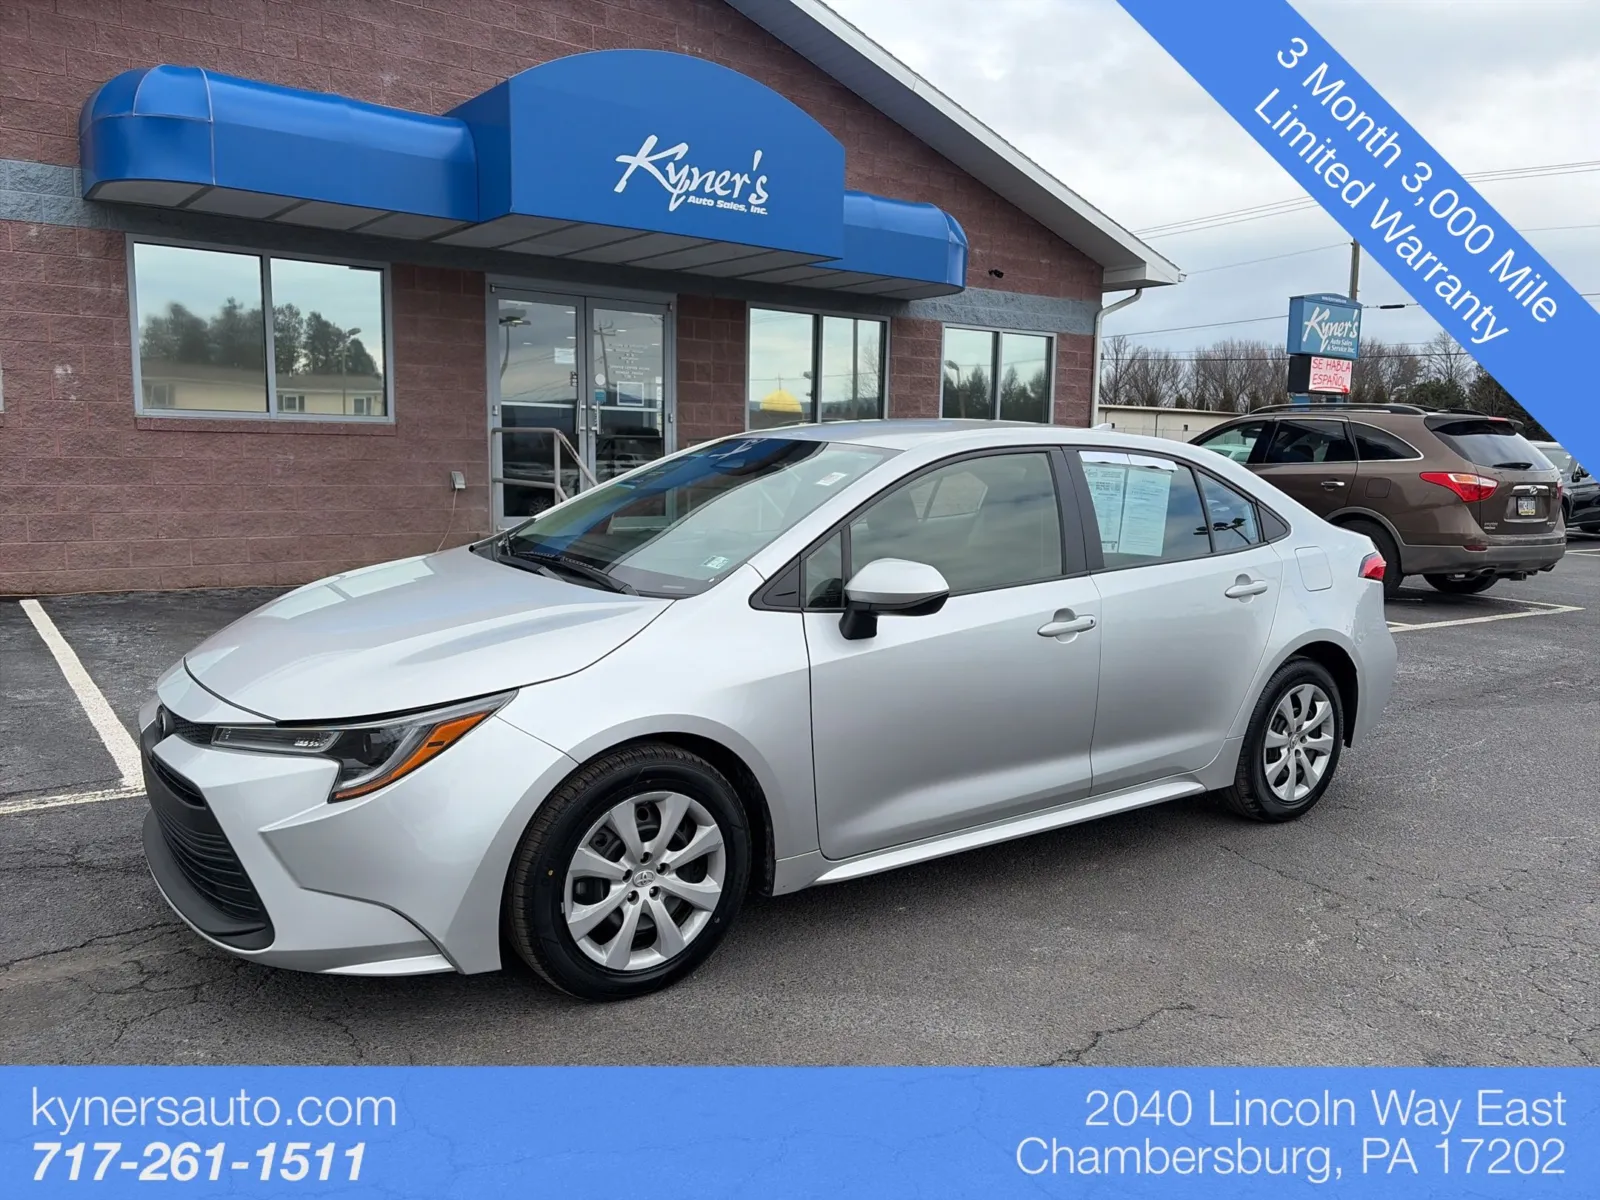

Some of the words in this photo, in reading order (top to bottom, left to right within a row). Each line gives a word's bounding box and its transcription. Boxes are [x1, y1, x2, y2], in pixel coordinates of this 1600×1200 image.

[614, 134, 769, 212] Kyner's
[687, 195, 714, 207] Auto
[716, 199, 747, 213] Sales,
[750, 205, 768, 215] Inc.
[1303, 306, 1359, 353] Kyner's
[1312, 358, 1324, 370] SE
[1326, 360, 1351, 373] HABLA
[1312, 373, 1346, 387] ESPAÑOL
